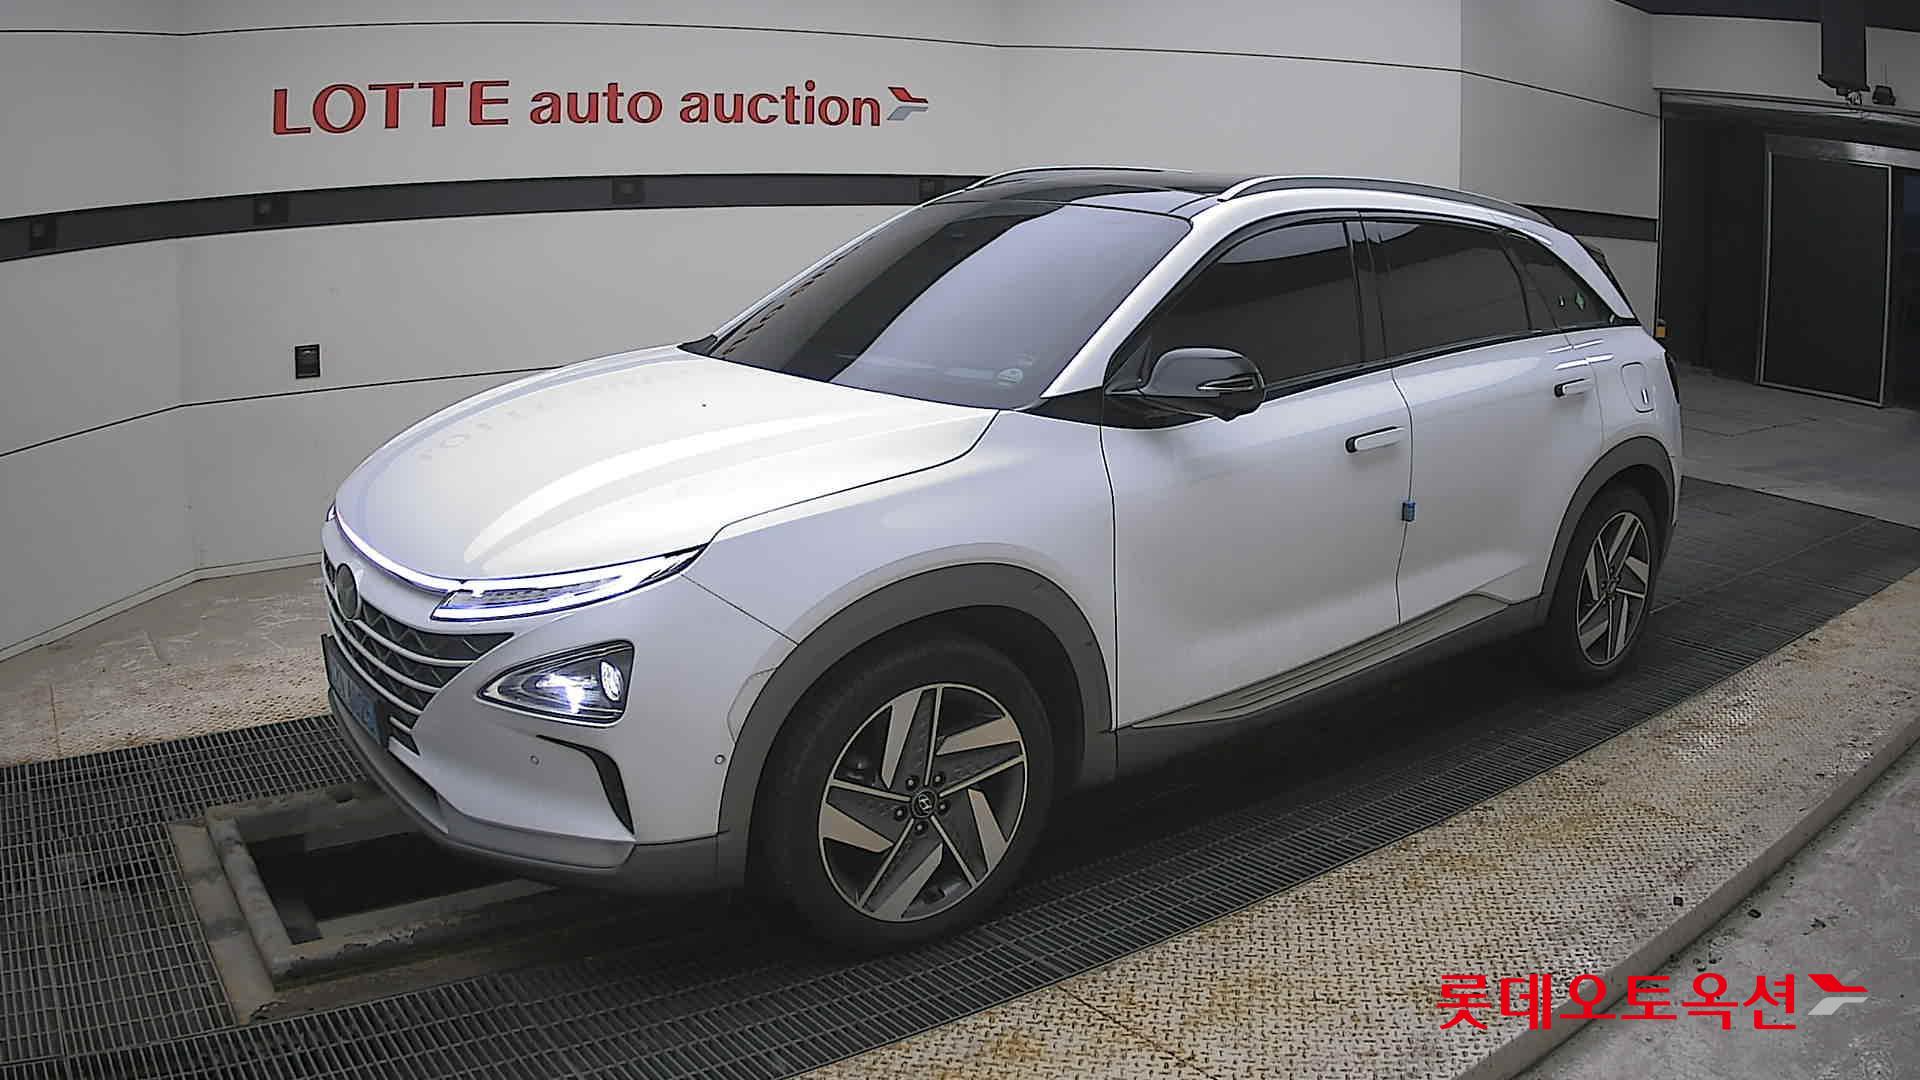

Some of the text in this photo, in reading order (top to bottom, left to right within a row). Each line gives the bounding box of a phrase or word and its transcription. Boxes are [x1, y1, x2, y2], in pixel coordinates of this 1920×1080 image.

[273, 79, 881, 135] LOTTE auto auction
